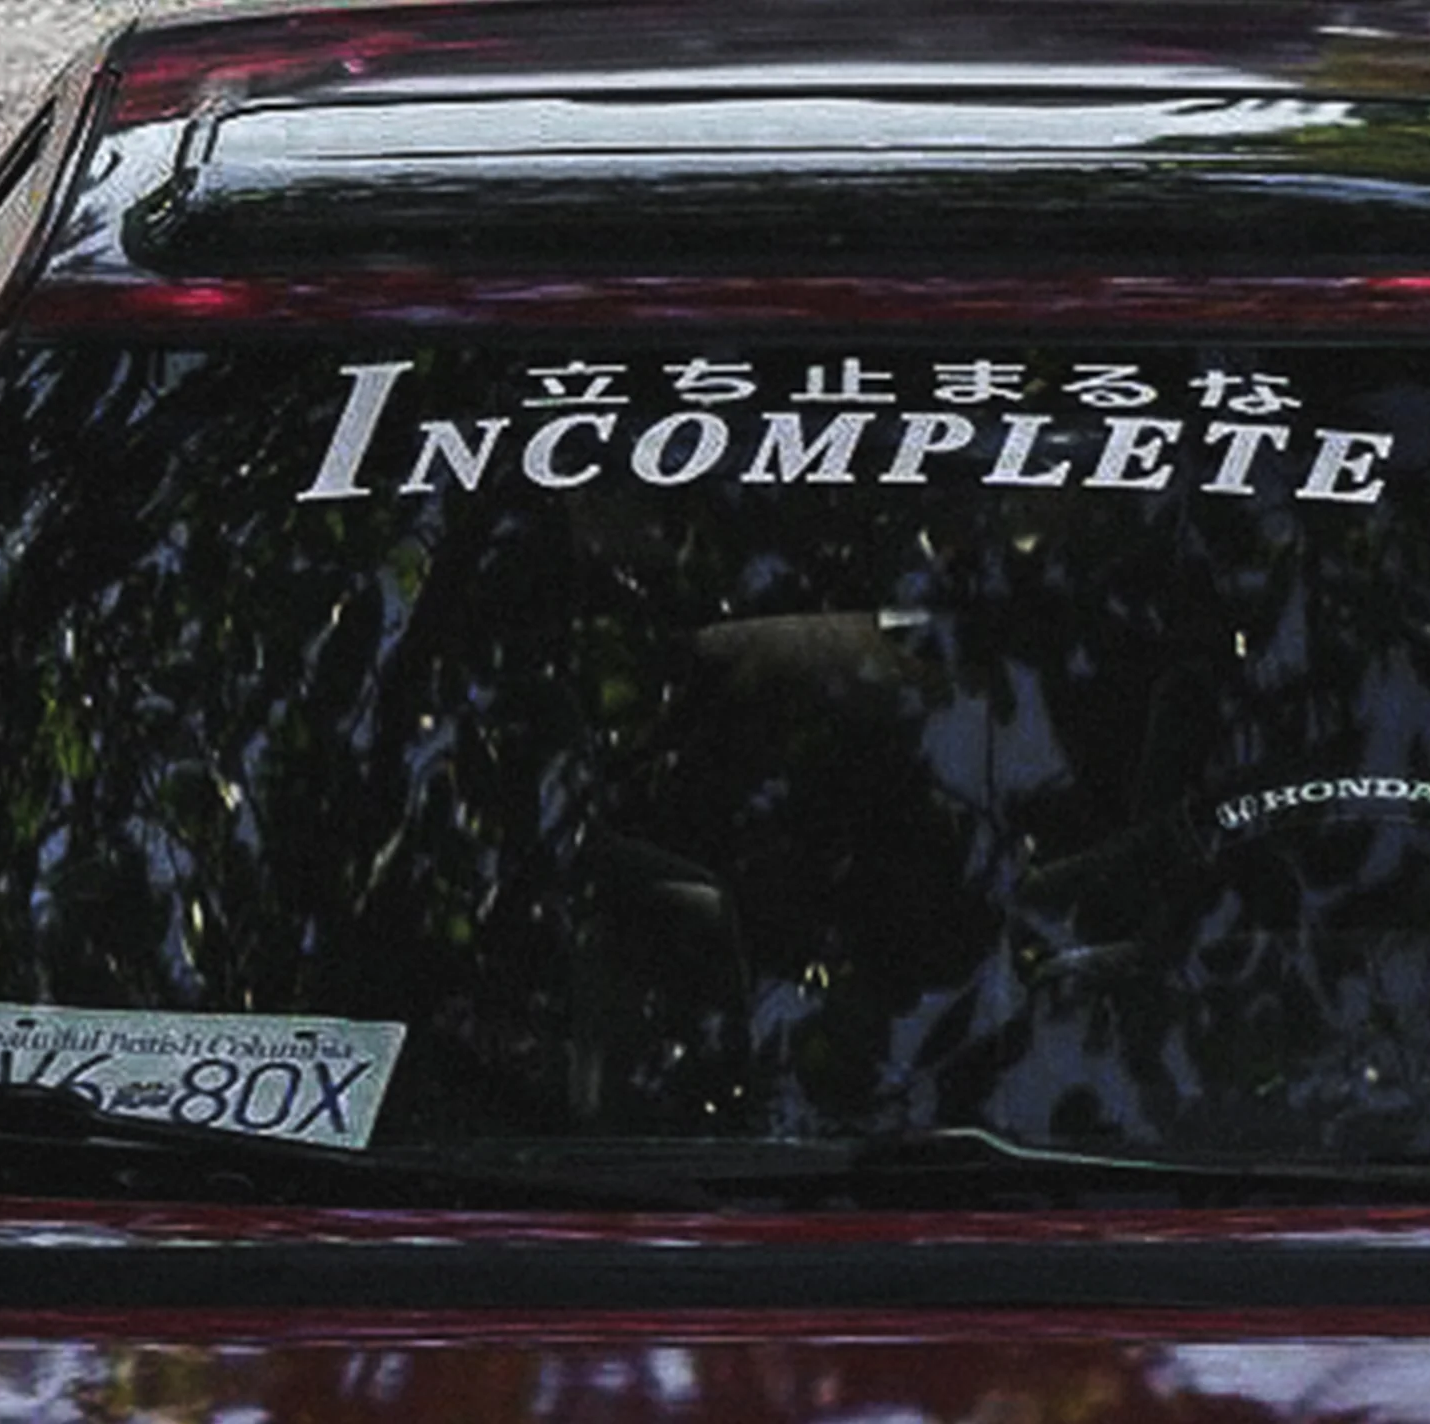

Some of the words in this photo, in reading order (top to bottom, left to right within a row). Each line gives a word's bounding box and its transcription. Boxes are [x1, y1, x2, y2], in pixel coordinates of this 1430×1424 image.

[297, 361, 1394, 504] INCOMPLETE
[522, 359, 1303, 415] 立ち止まるな
